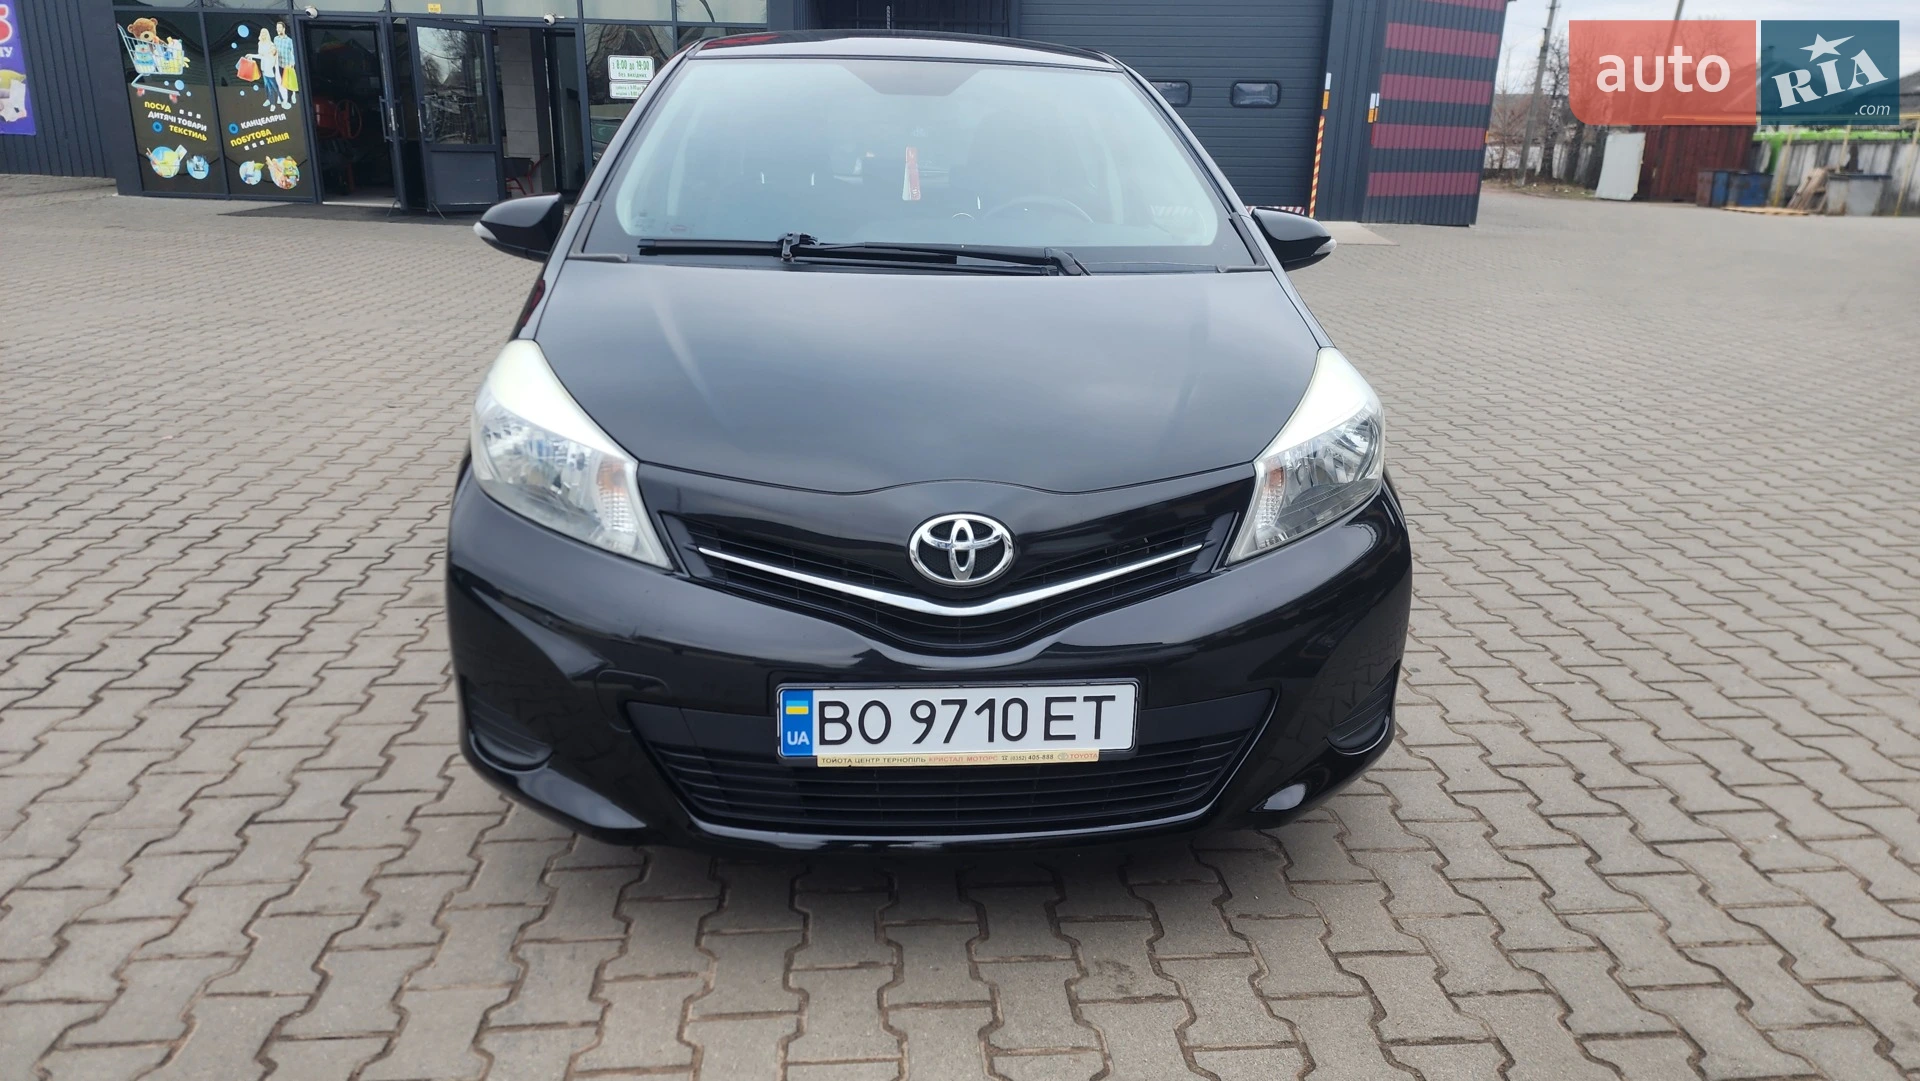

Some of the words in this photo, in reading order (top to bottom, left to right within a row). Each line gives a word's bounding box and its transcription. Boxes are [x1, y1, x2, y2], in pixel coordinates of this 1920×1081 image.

[144, 101, 172, 113] ПОСУД
[147, 110, 177, 123] ДИТЯЧІ
[177, 117, 207, 132] ТОВАРИ
[240, 113, 287, 129] КАНЦЕЛЯРІЯ
[169, 124, 208, 141] ТЕКСТИЛЬ
[230, 128, 272, 147] ПОБУТОВА
[266, 132, 290, 144] ХІМІЯ
[819, 700, 892, 745] BO
[910, 697, 1029, 745] 9710
[1043, 695, 1117, 741] ET
[787, 731, 810, 746] UA
[966, 755, 998, 763] МОТОРС
